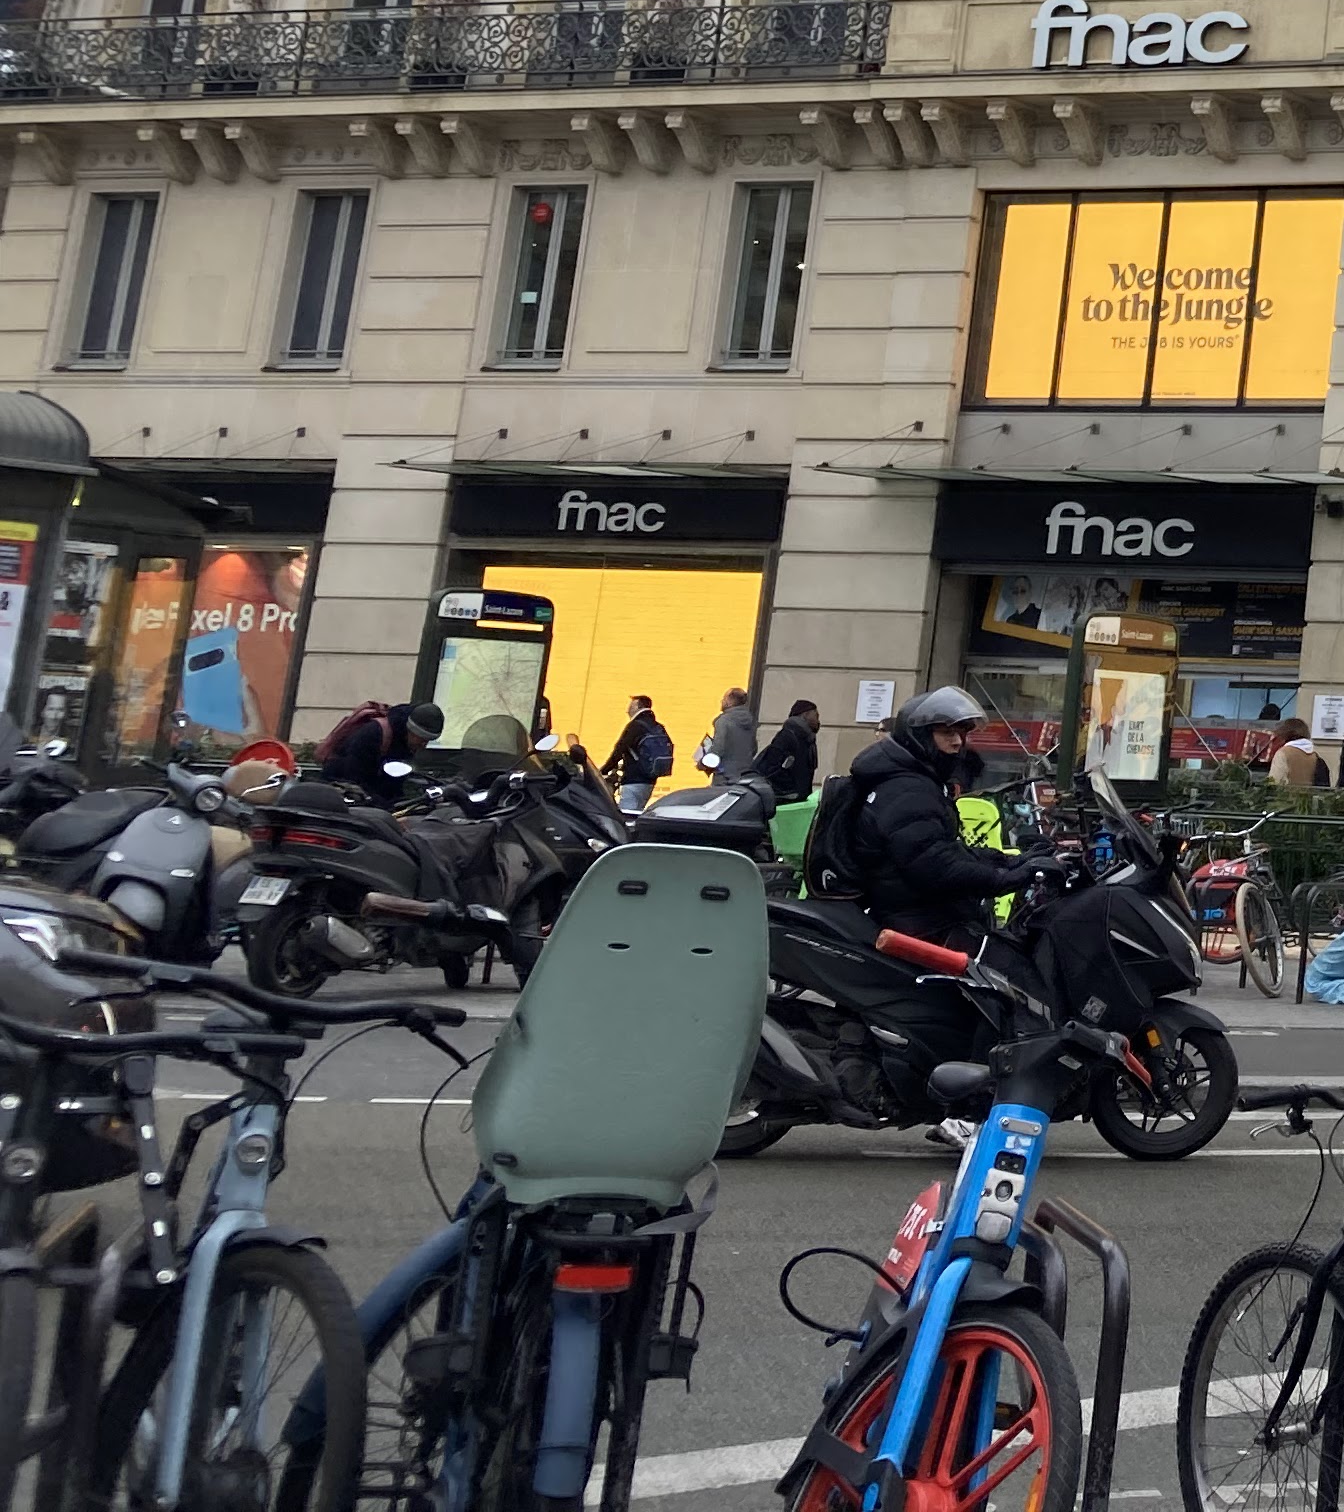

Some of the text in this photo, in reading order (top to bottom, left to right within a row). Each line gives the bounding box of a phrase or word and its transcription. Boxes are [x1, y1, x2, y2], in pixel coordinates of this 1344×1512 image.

[1108, 262, 1255, 291] Wecome
[1081, 294, 1114, 322] to
[1111, 337, 1136, 349] THE
[1139, 337, 1167, 348] JB
[1171, 337, 1184, 348] IS
[556, 489, 667, 533] fnac
[1045, 500, 1196, 557] fnac
[236, 603, 255, 632] 8
